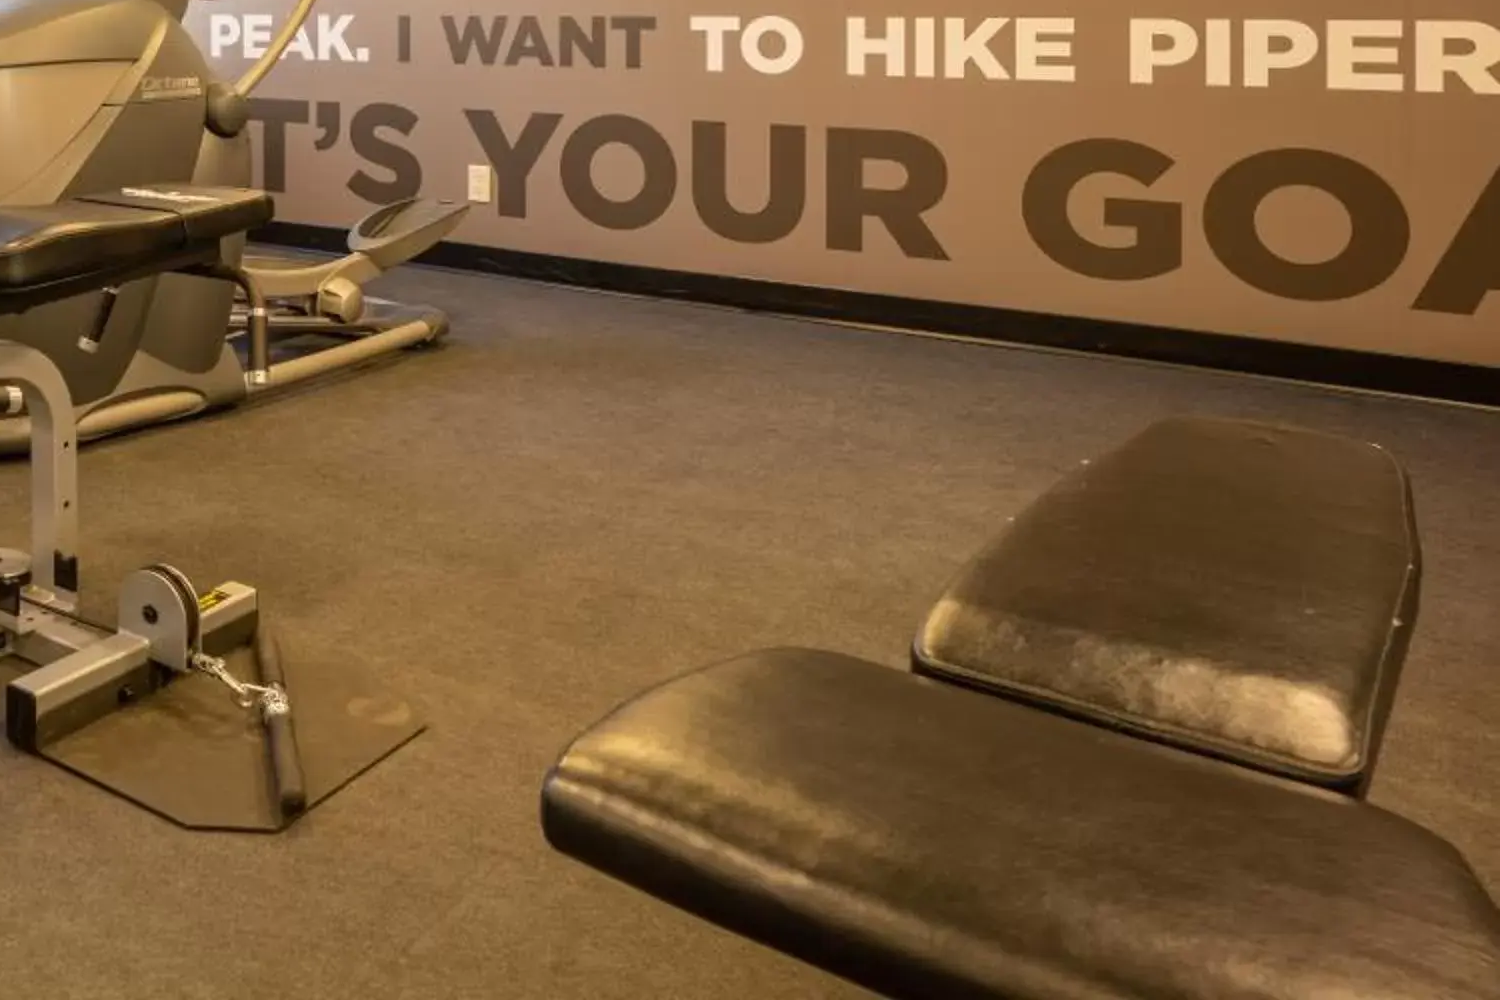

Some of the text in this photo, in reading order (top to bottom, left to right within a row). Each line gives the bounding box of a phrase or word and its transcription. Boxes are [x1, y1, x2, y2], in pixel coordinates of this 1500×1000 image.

[210, 13, 369, 63] PEAK.
[398, 15, 412, 63] I
[441, 15, 656, 70] WANT
[690, 15, 804, 75] TO
[846, 16, 1076, 83] HIKE
[463, 108, 951, 262] YOUR
